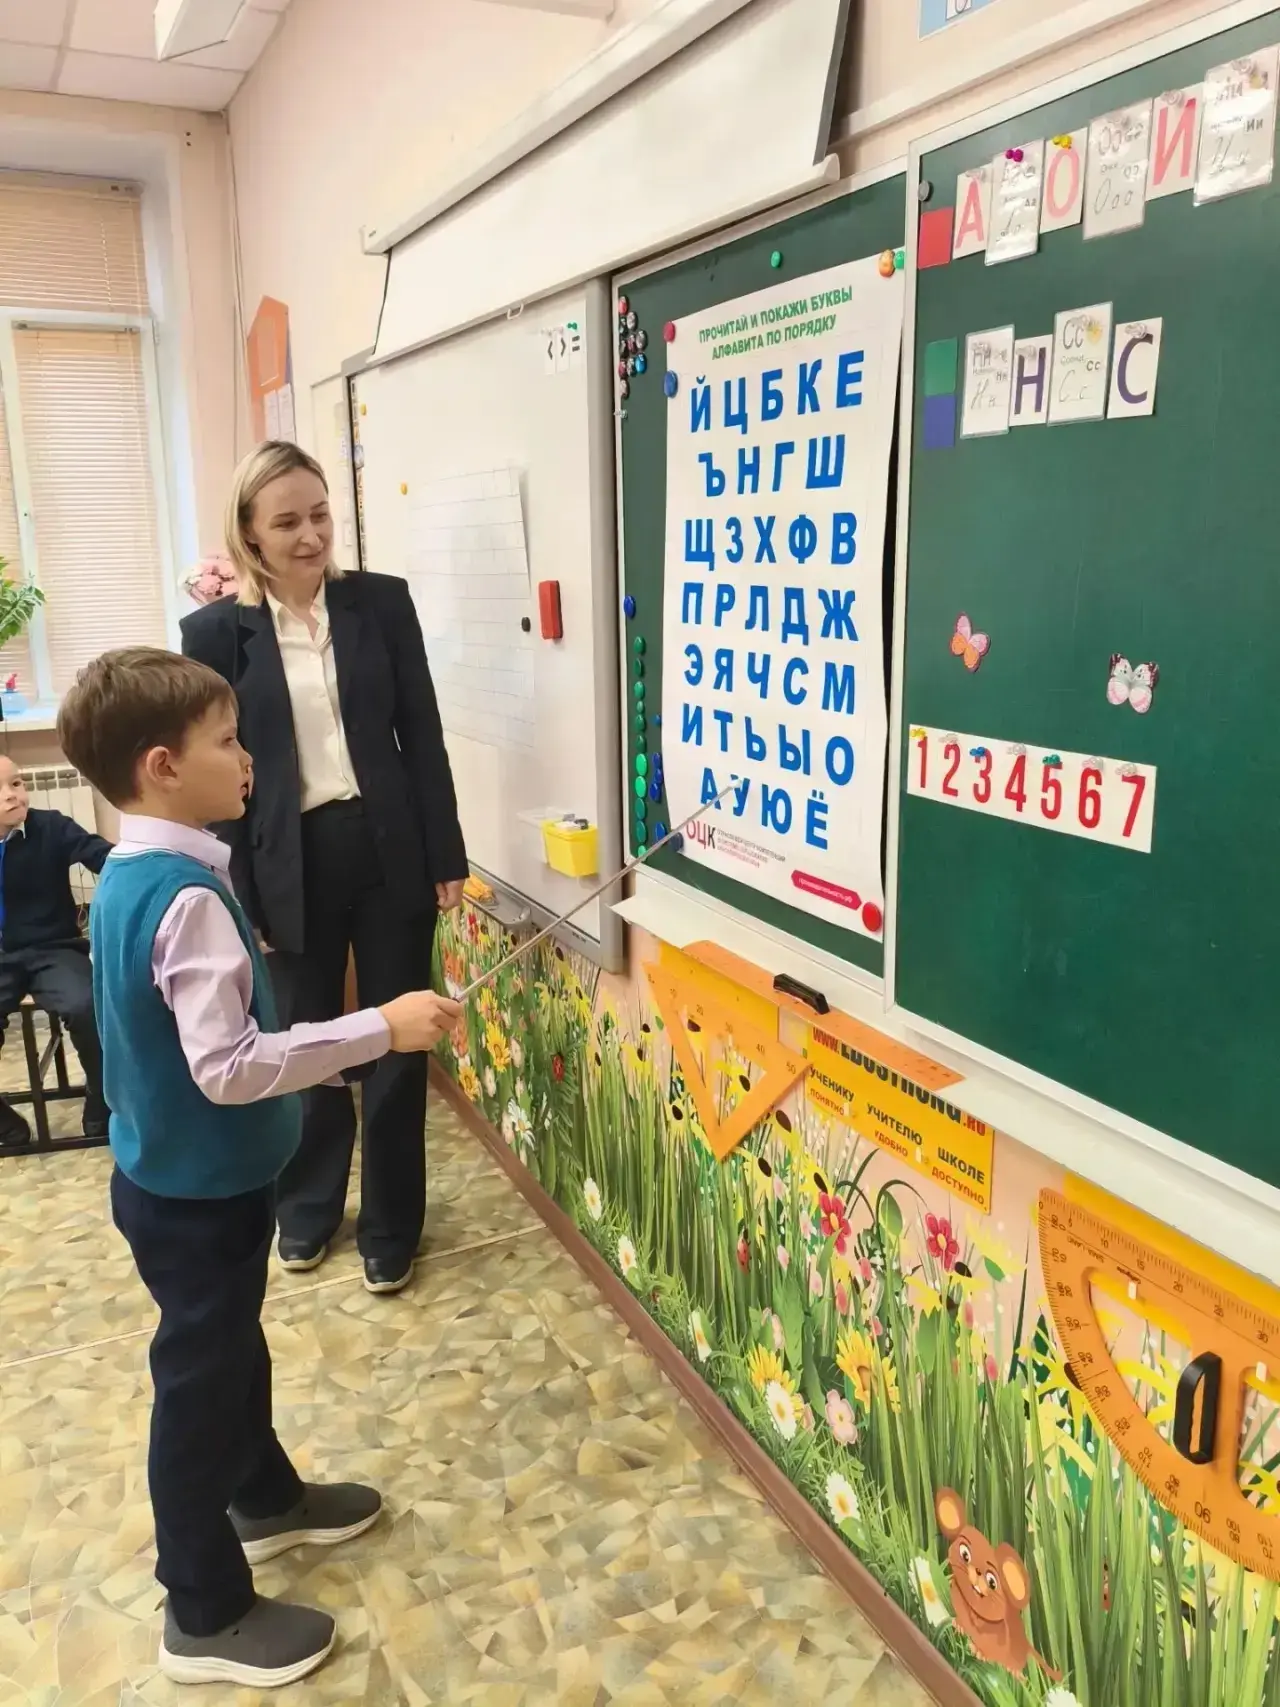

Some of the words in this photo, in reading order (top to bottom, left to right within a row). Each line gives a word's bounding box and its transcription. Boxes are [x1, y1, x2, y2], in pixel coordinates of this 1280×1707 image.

[955, 177, 984, 249] А
[699, 315, 749, 343] ПРОЧИТАЙ
[750, 312, 758, 328] И
[760, 299, 809, 325] ПОКАЖИ
[811, 285, 853, 312] БУКВЫ
[711, 334, 764, 361] АЛФАВИТА
[767, 329, 782, 346] ПО
[784, 314, 837, 342] ПОРЯДКУ
[809, 1066, 854, 1102] УЧЕНИКУ
[867, 1102, 923, 1146] УЧИТЕЛЮ
[938, 1147, 985, 1185] ШКОЛЕ
[874, 1130, 908, 1157] УДОБНО
[932, 1166, 985, 1205] ДОСТУПНО
